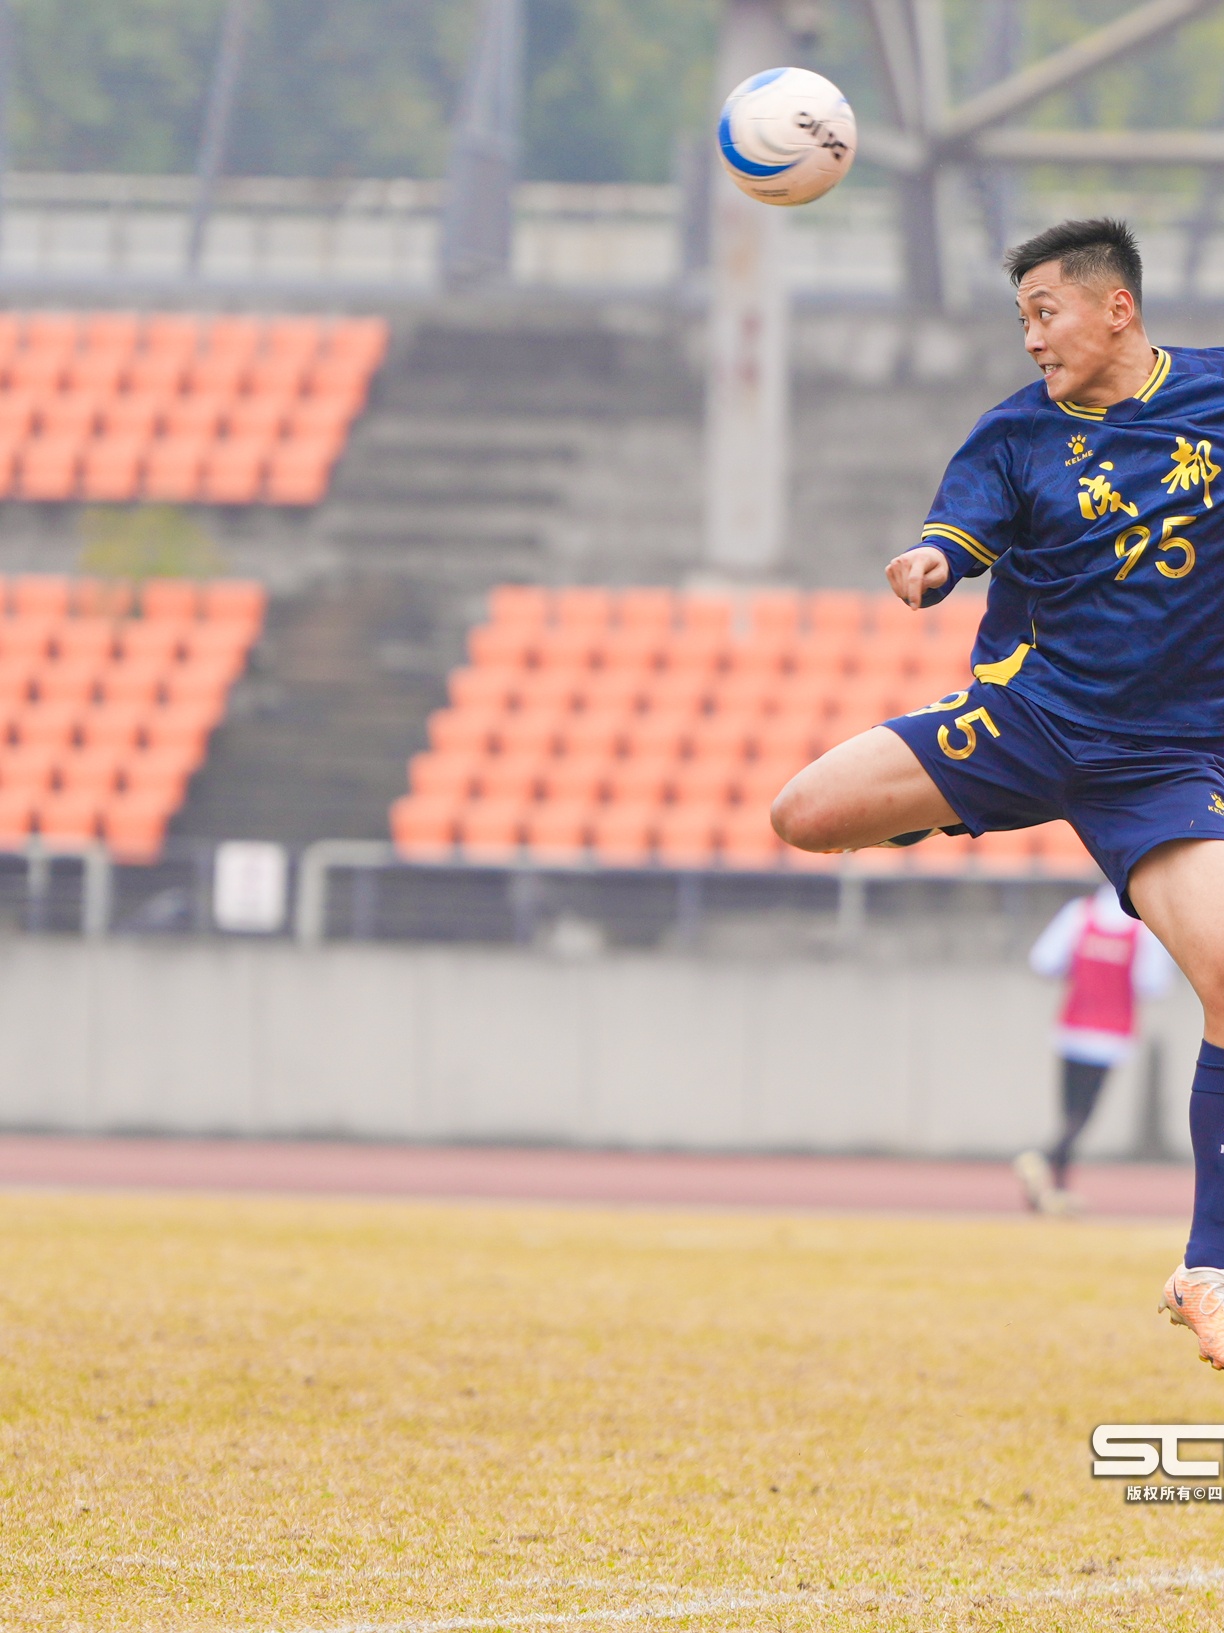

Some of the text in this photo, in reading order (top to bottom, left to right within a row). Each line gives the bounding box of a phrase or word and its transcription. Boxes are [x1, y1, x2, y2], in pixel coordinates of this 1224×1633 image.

[1064, 449, 1094, 467] KELME
[1077, 436, 1222, 520] 成都
[1114, 516, 1197, 581] 95
[905, 690, 1001, 761] 95
